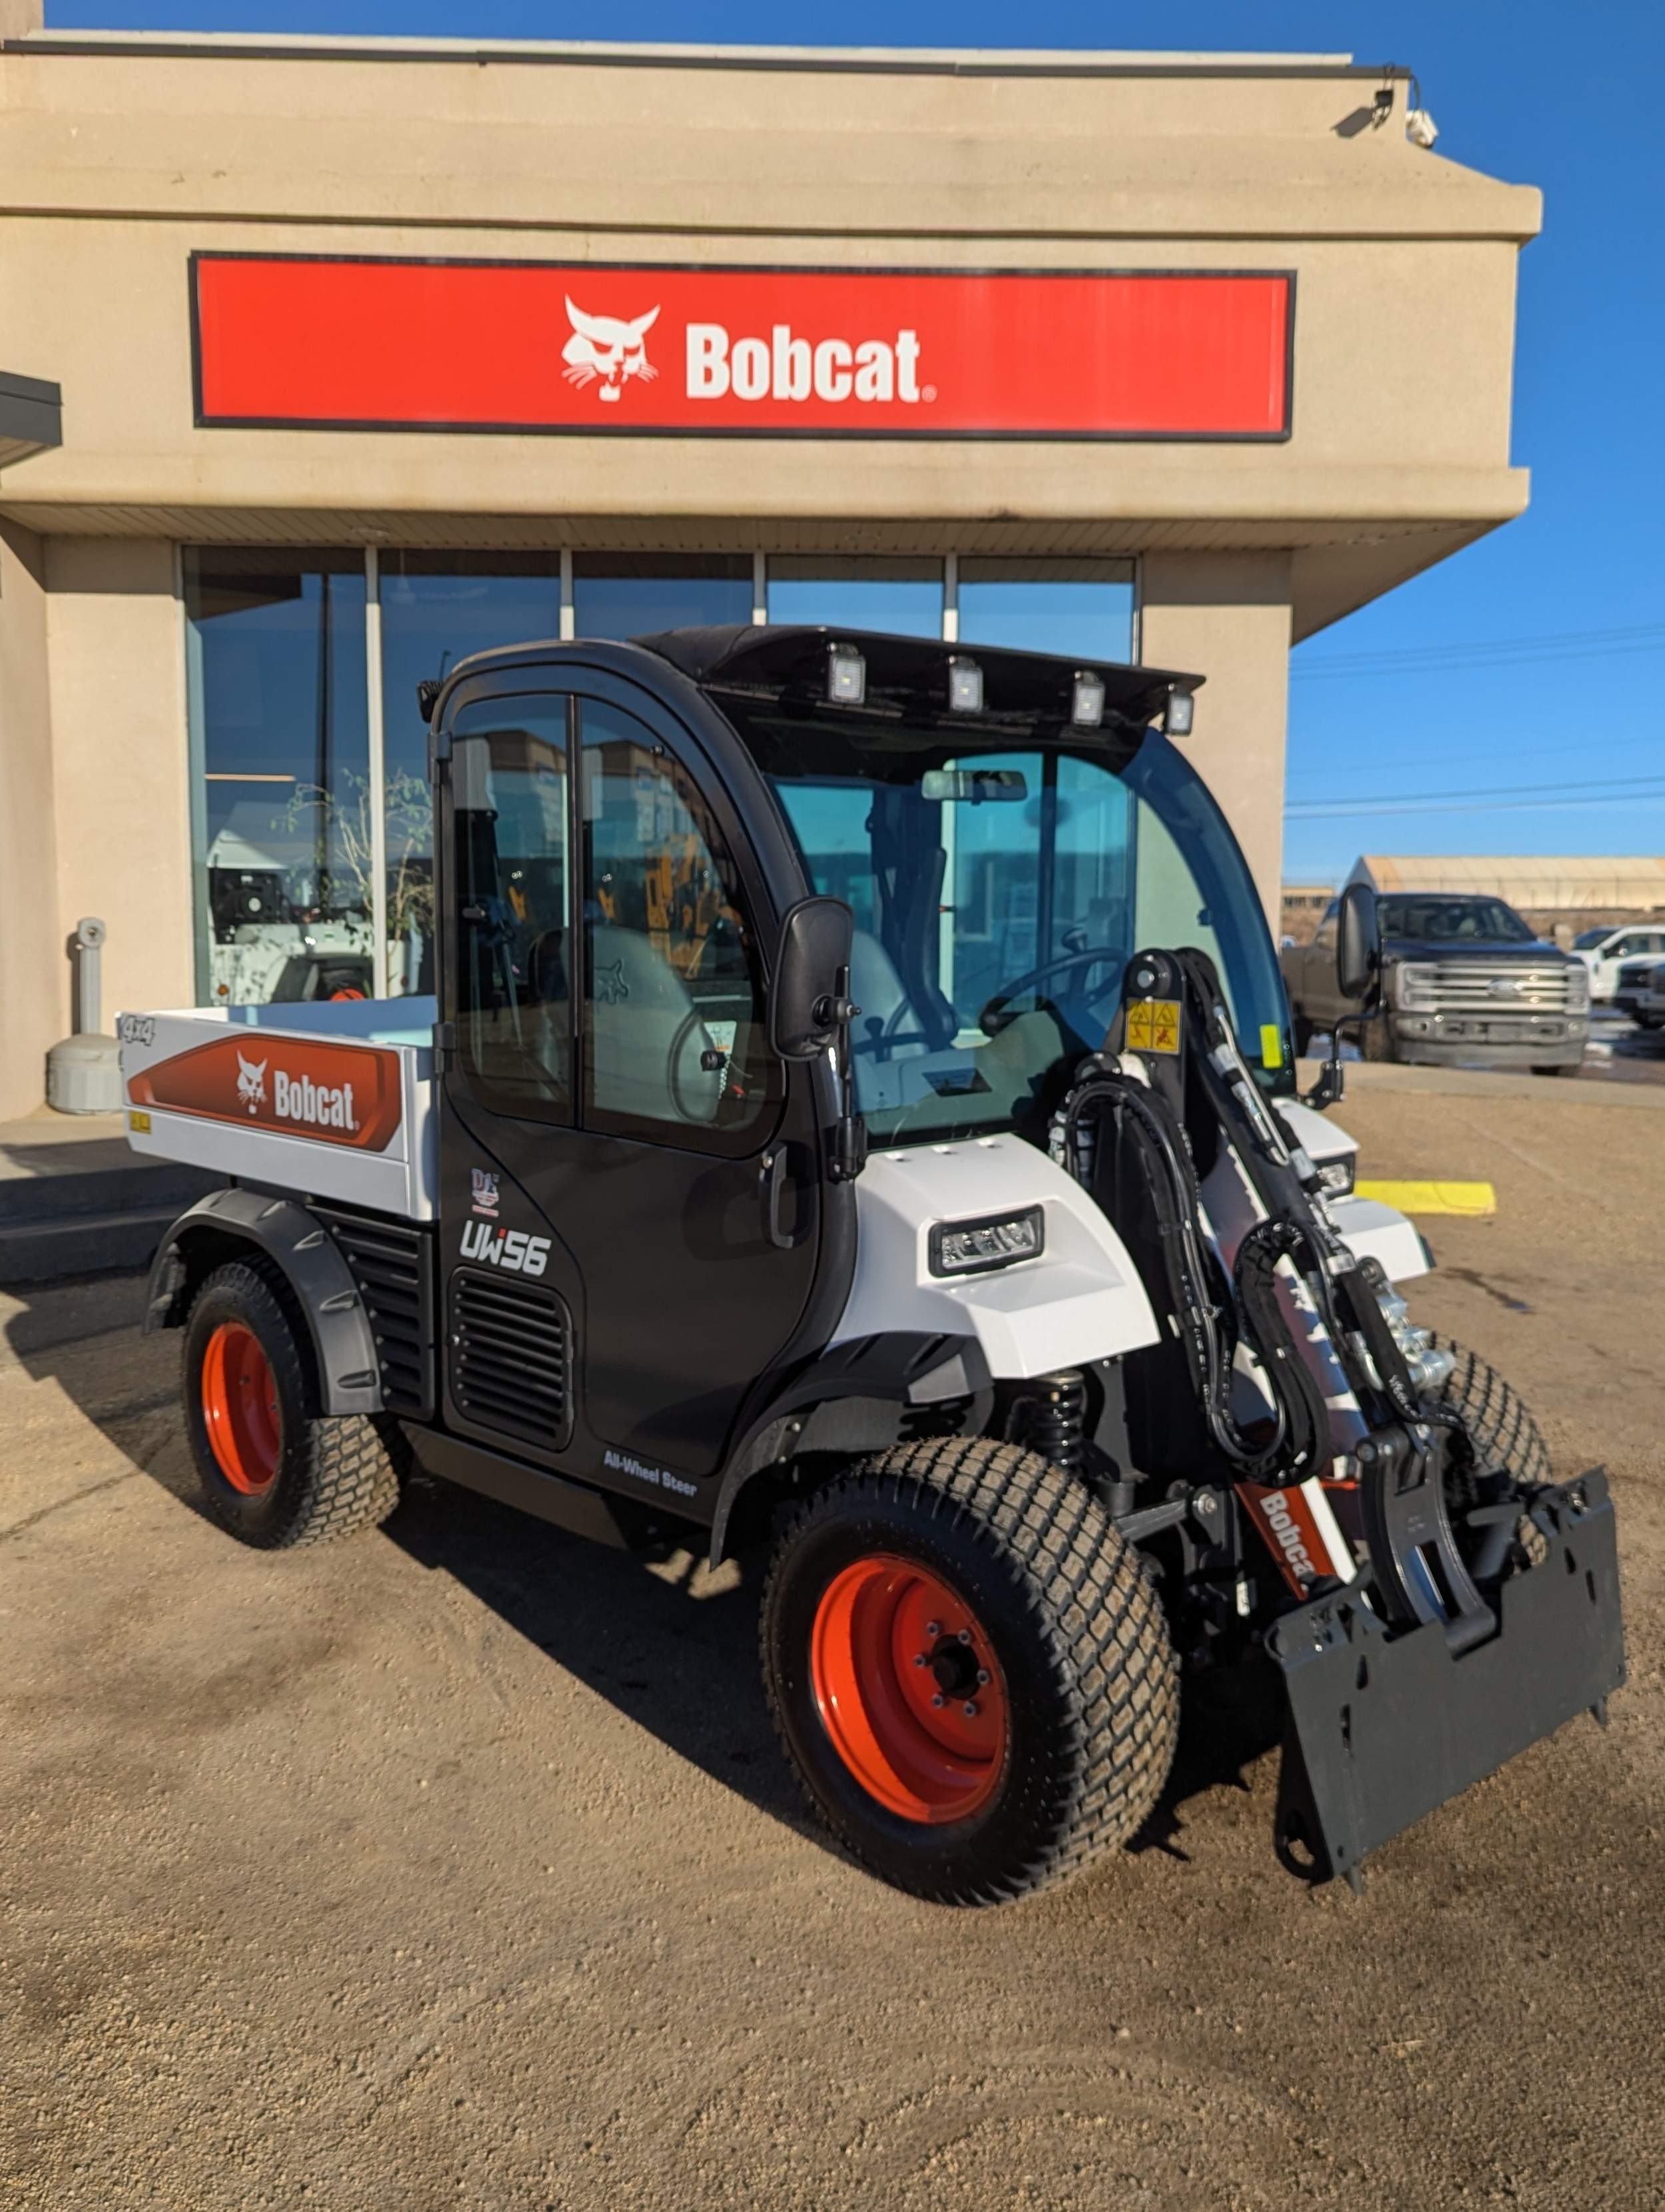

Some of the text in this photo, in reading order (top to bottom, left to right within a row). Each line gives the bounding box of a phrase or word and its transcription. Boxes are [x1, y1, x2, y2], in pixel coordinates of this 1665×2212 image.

[686, 322, 921, 403] Bobcat
[122, 1014, 156, 1047] 4x4
[274, 1069, 355, 1131] Bobcat
[459, 1219, 552, 1276] UW56
[603, 1450, 698, 1498] All-Wheel Steer
[1260, 1490, 1316, 1592] Bobca
